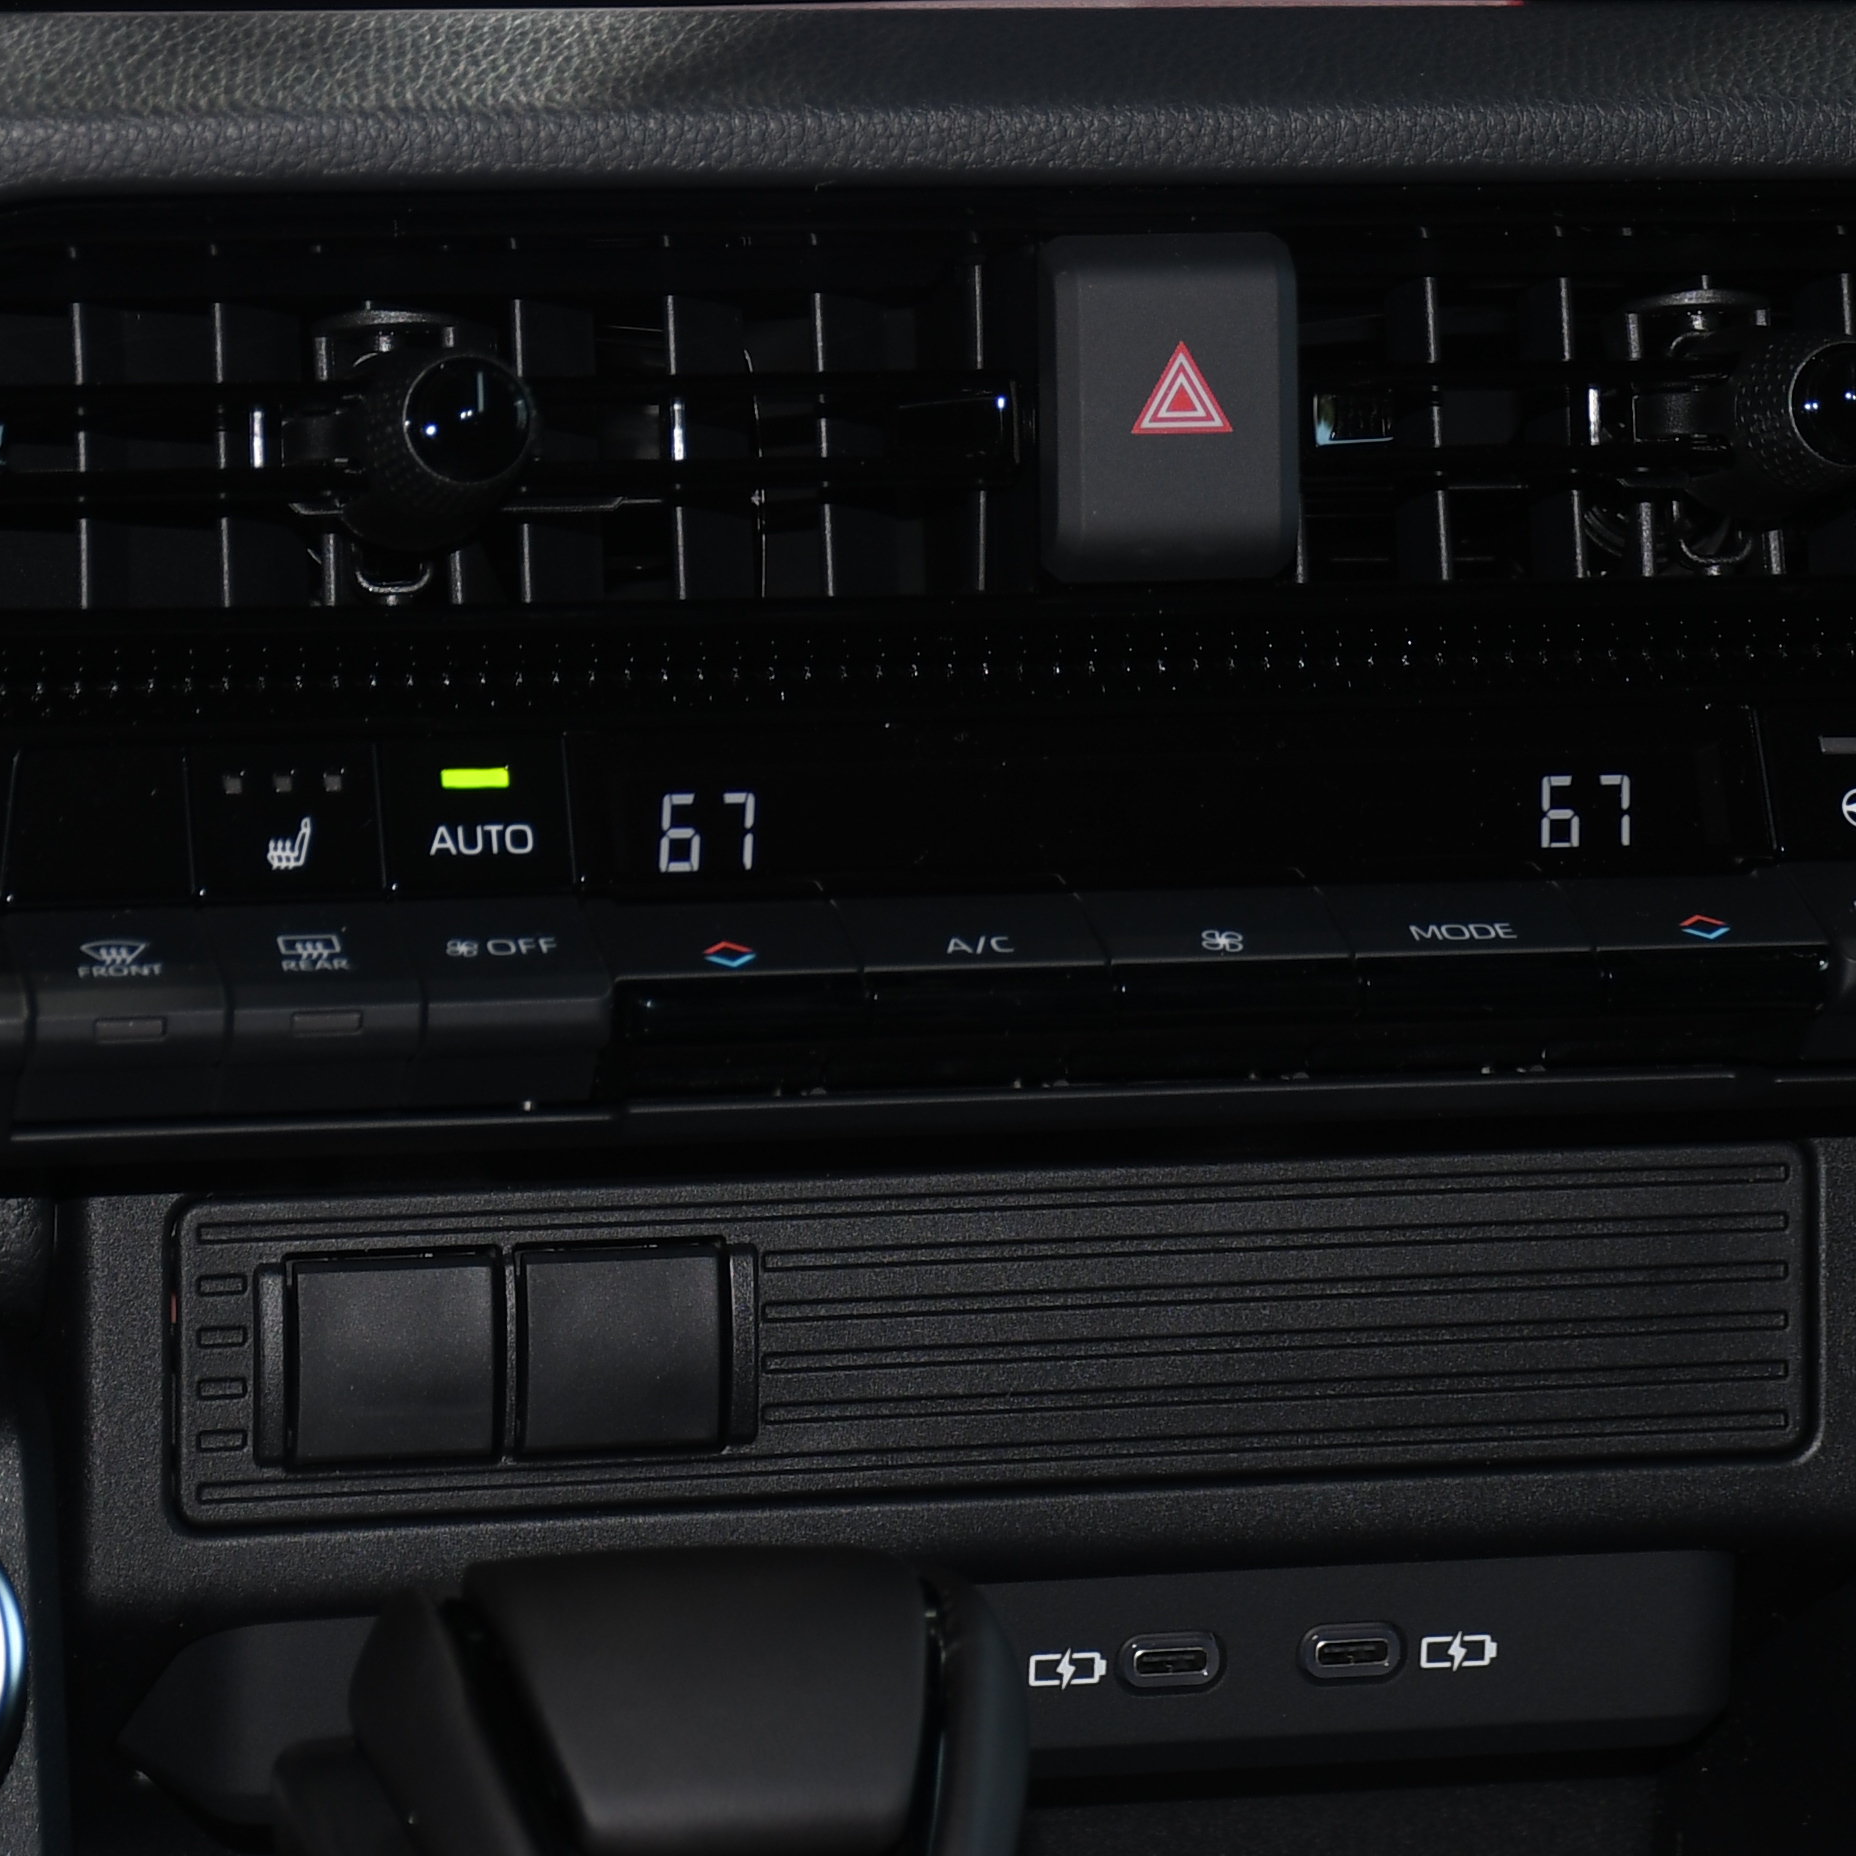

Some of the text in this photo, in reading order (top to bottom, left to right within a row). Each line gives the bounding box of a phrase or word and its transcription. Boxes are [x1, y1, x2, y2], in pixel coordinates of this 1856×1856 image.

[1537, 772, 1633, 850] 67
[428, 822, 535, 858] AUTO
[656, 788, 758, 875] 67
[1407, 921, 1520, 943] MODE
[486, 935, 559, 959] OFF
[944, 933, 1016, 956] A/C
[76, 962, 164, 979] FRONT
[280, 955, 350, 973] REAR
